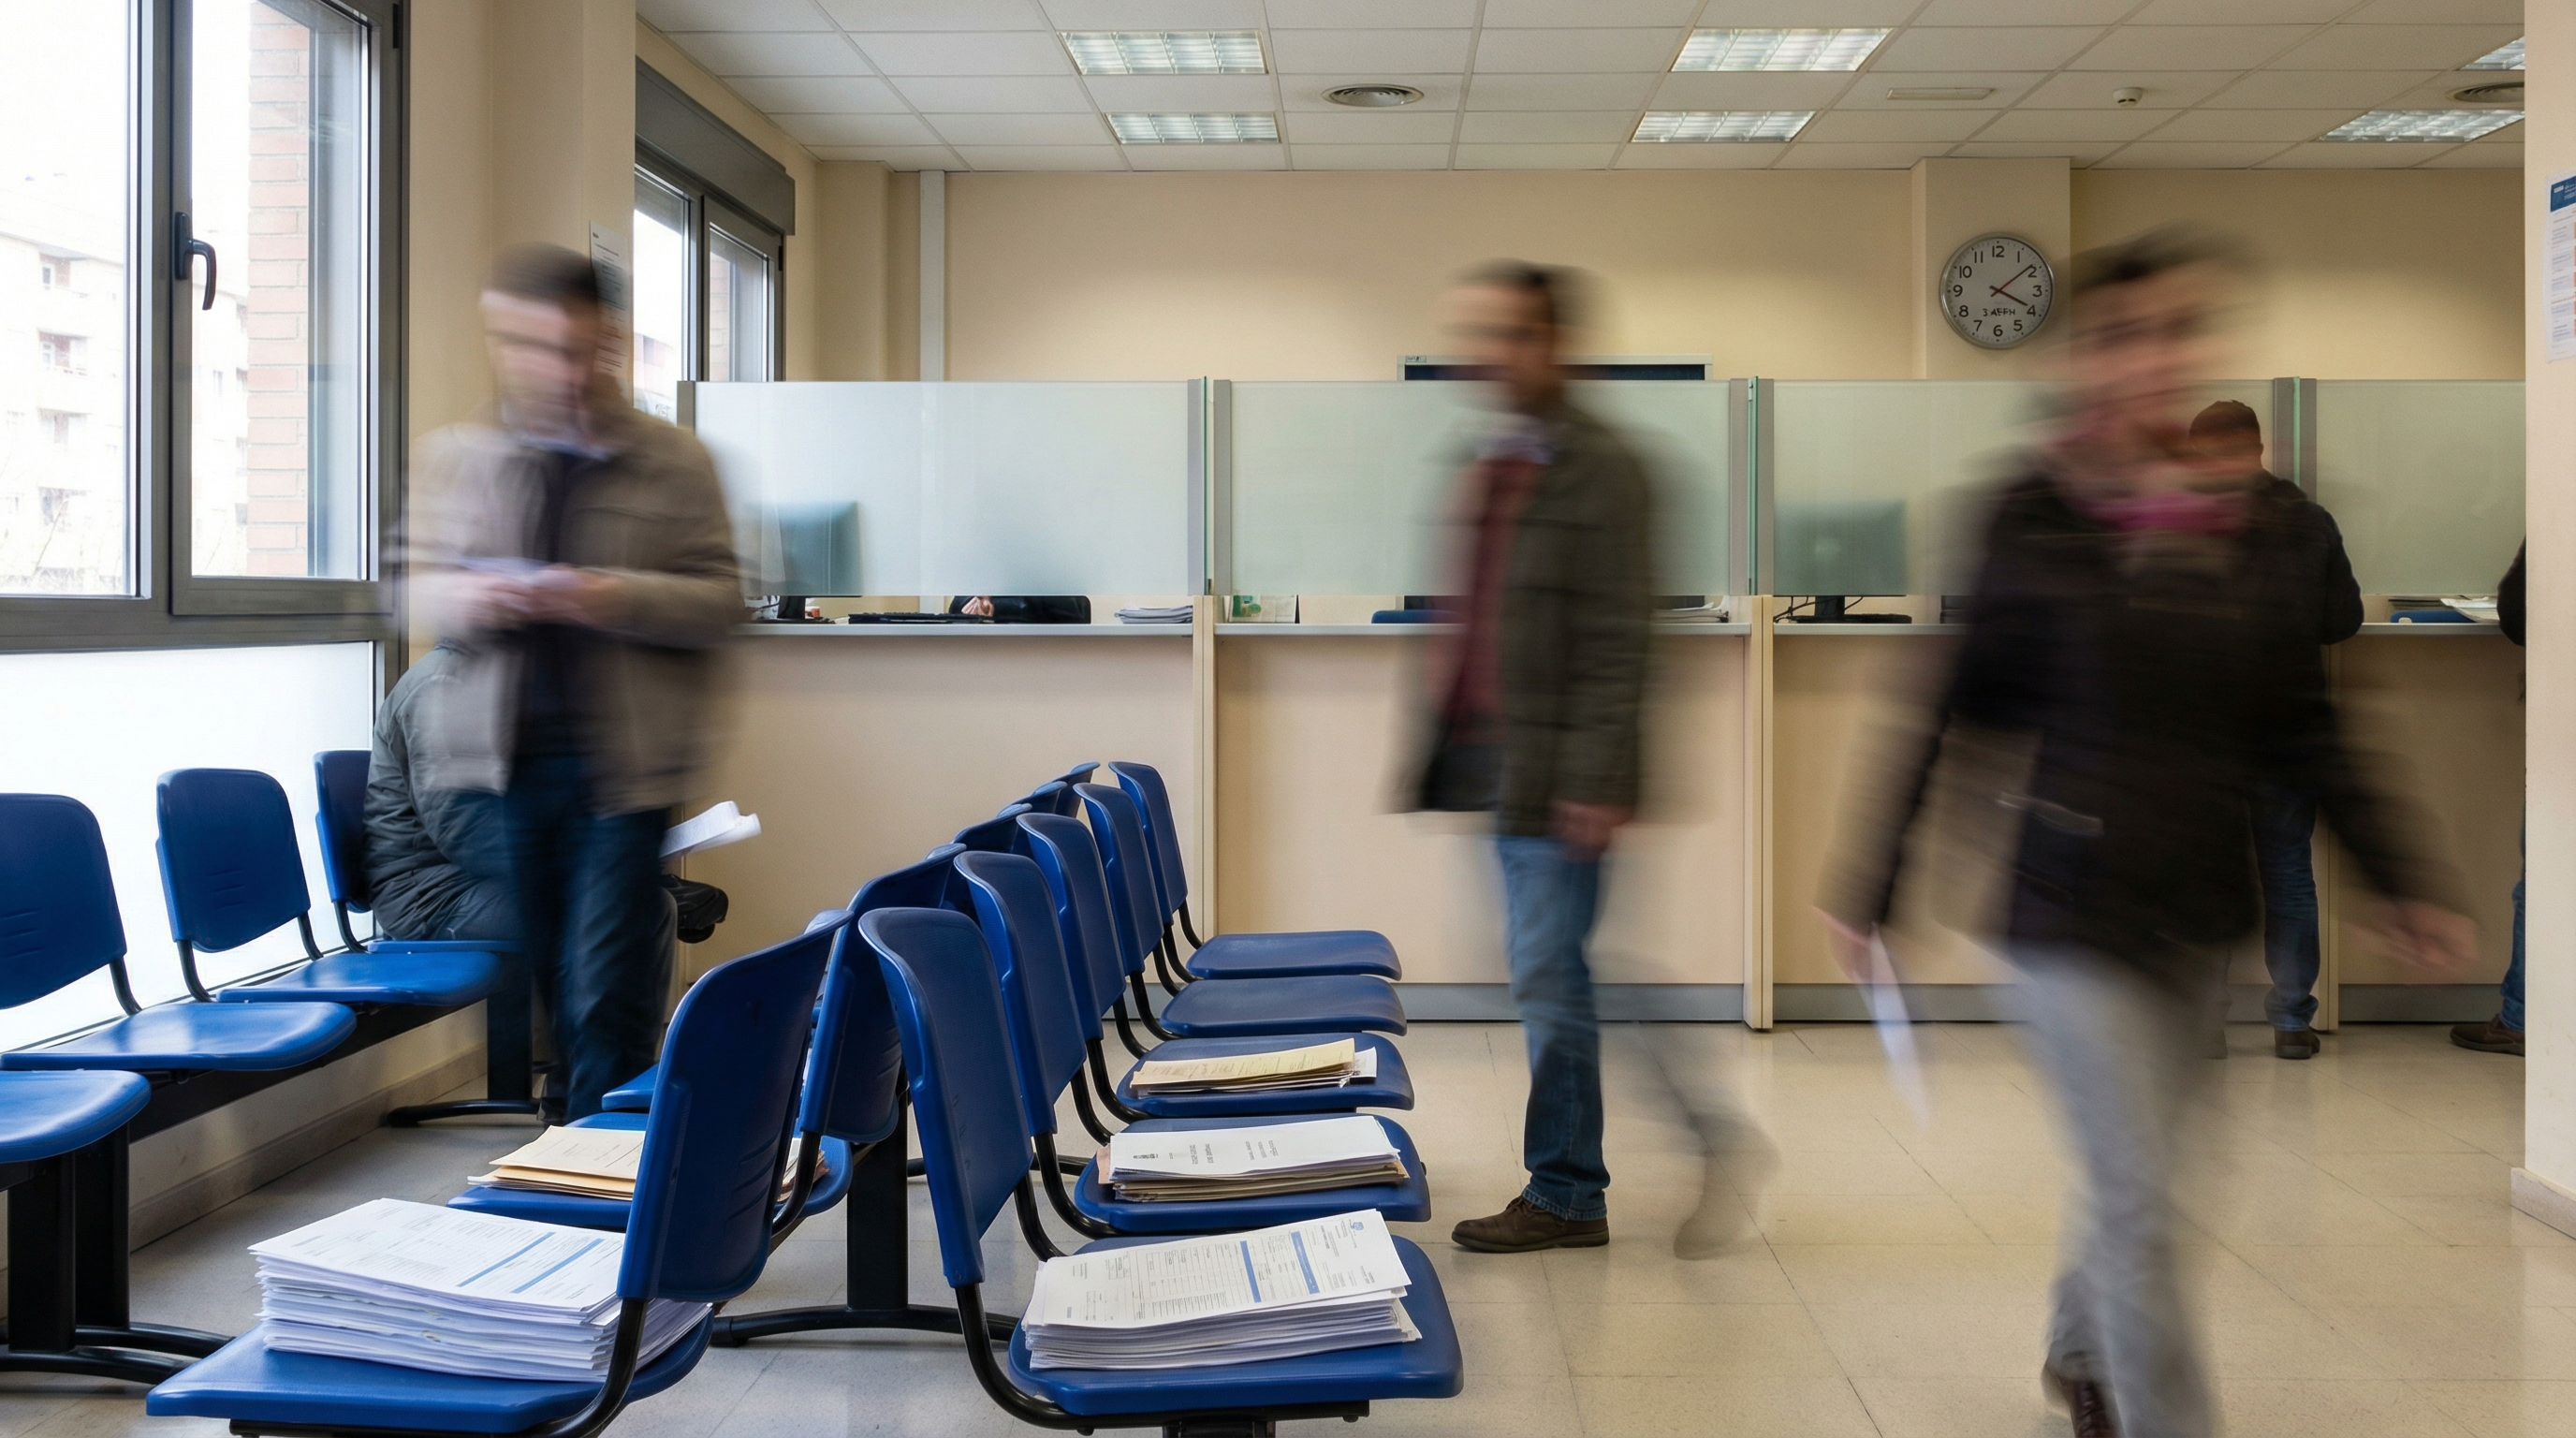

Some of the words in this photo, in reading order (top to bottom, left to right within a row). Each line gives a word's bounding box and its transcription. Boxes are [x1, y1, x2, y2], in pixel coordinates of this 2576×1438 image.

[1974, 251, 1983, 263] 11
[1992, 245, 2005, 257] 12
[2017, 251, 2020, 263] 1
[1959, 266, 1972, 278] 10
[2027, 265, 2037, 278] 2
[1953, 285, 1963, 297] 9
[2032, 285, 2042, 298] 3
[1958, 305, 1969, 317] 8
[2027, 305, 2036, 317] 4
[1973, 320, 1983, 331] 7
[1993, 325, 2003, 337] 6
[2013, 320, 2023, 331] 5
